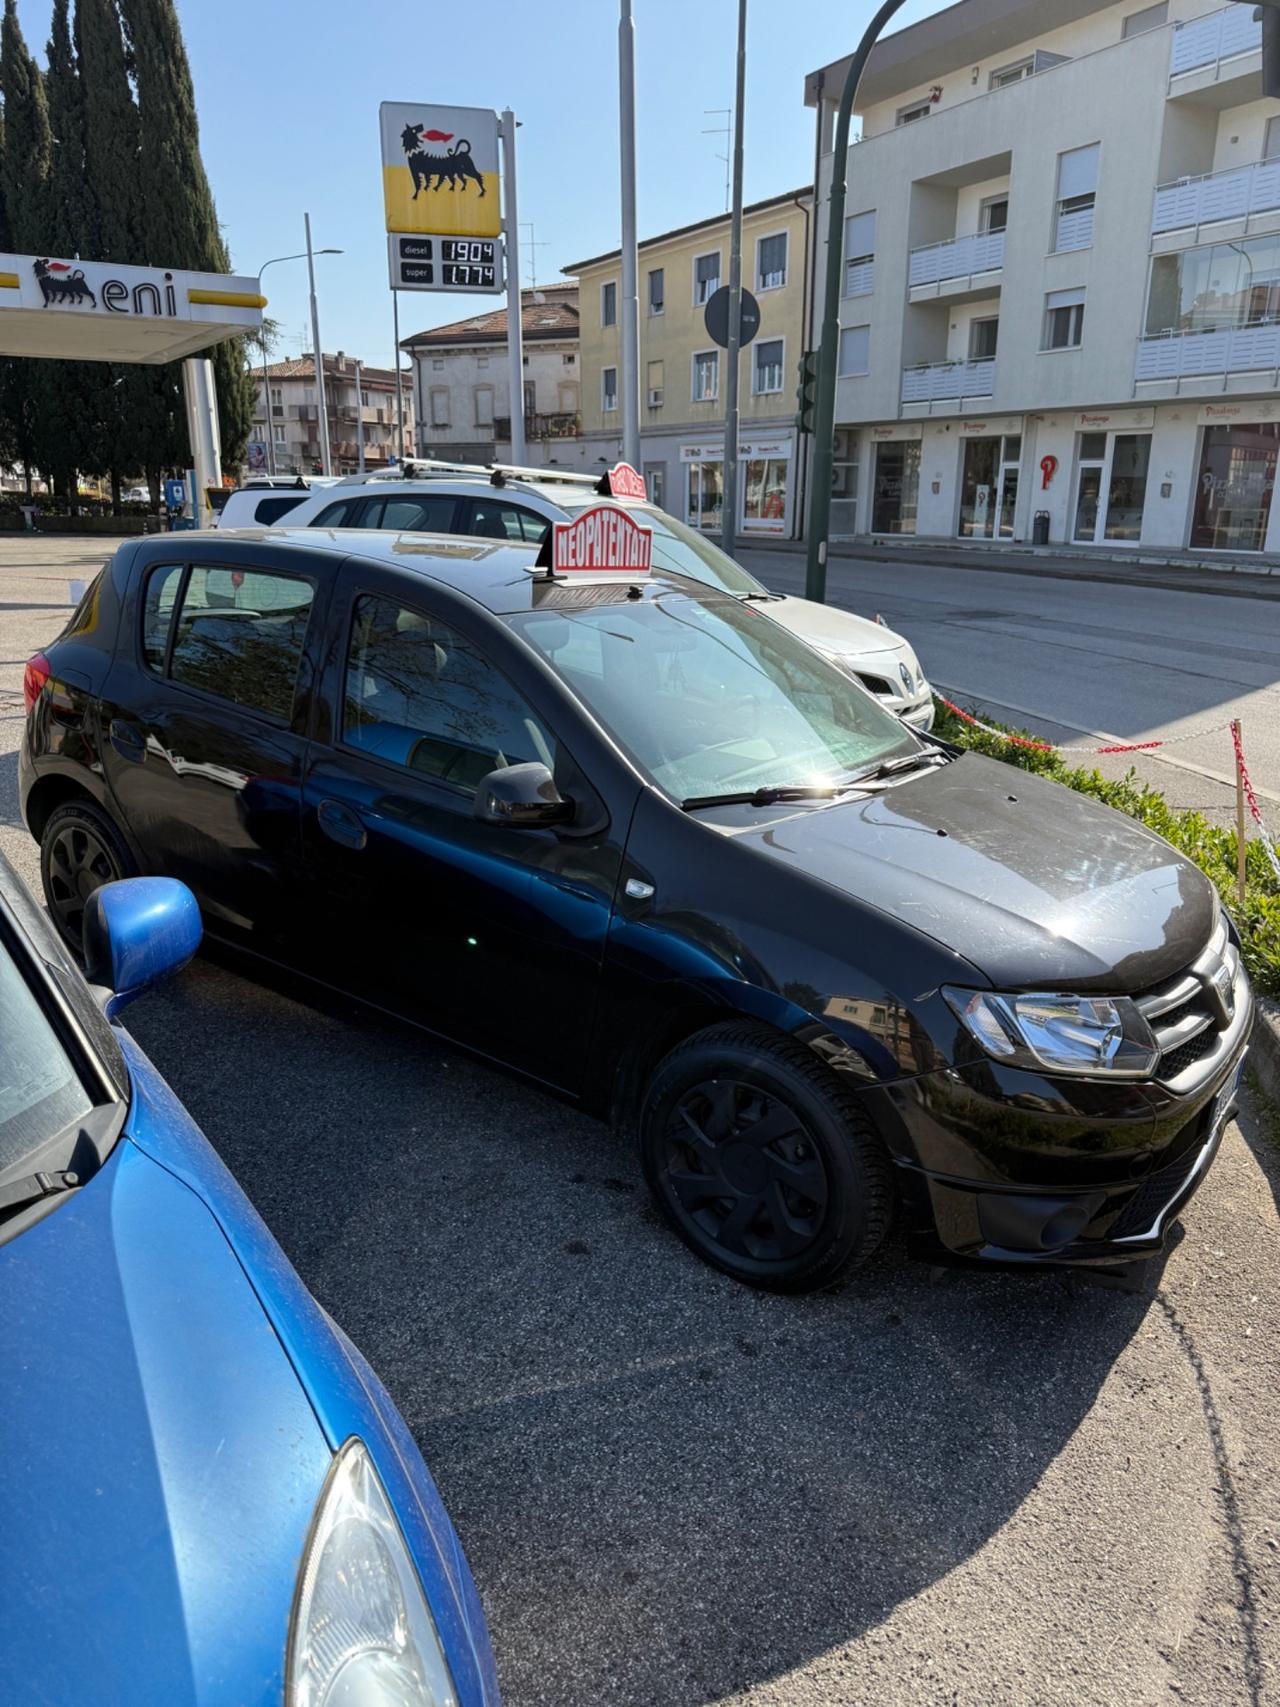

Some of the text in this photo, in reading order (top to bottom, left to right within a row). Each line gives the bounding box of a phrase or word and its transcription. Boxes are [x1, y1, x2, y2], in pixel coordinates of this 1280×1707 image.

[405, 245, 428, 255] diesel
[406, 268, 428, 278] super
[102, 272, 177, 317] eni
[557, 510, 650, 568] NEOPATENTATI
